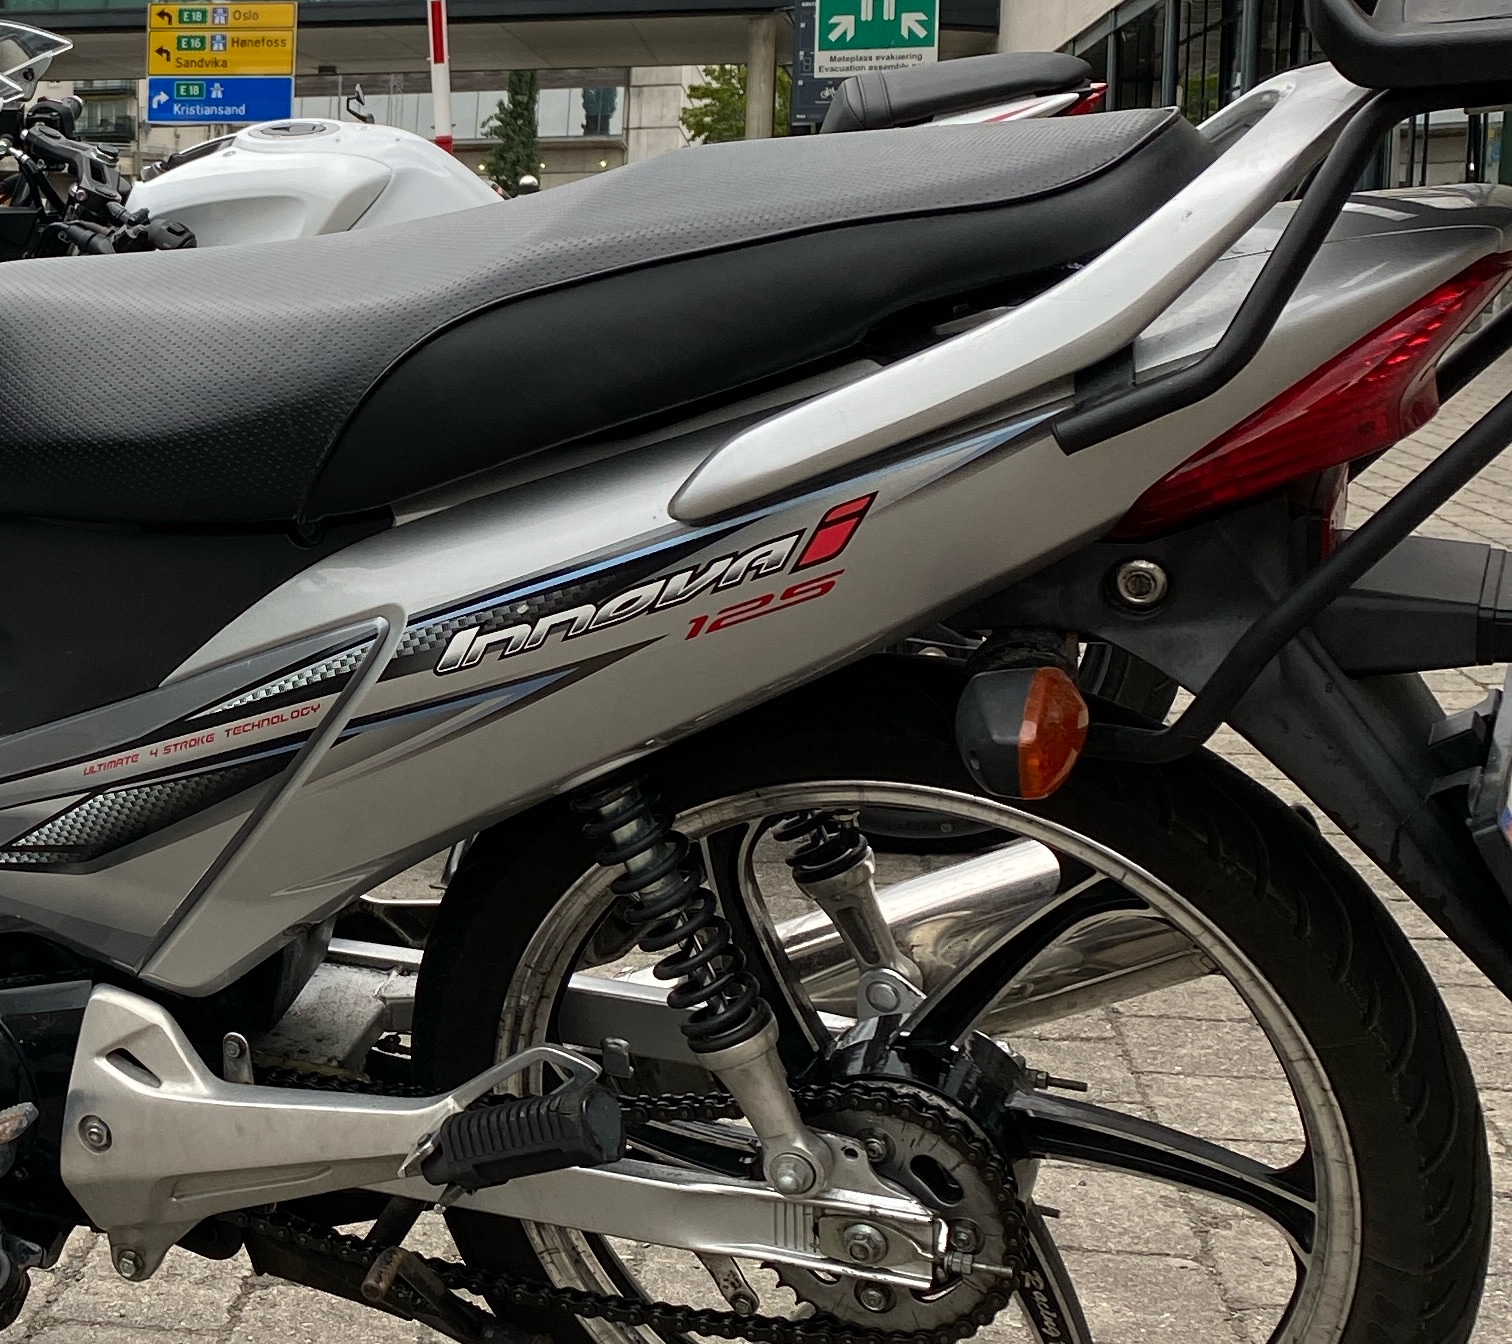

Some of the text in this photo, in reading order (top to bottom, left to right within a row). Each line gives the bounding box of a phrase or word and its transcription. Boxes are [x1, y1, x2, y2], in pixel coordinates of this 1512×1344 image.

[232, 9, 259, 22] Oslo
[231, 36, 287, 48] Hønefoss
[175, 57, 228, 69] Sandvika
[829, 53, 923, 63] Møteplass evakuering
[818, 63, 866, 73] Evacuation
[173, 103, 246, 116] Kristiansand
[685, 568, 846, 641] 125
[83, 703, 322, 777] ULTIMATE 4 STROKE TECHNOLOGY
